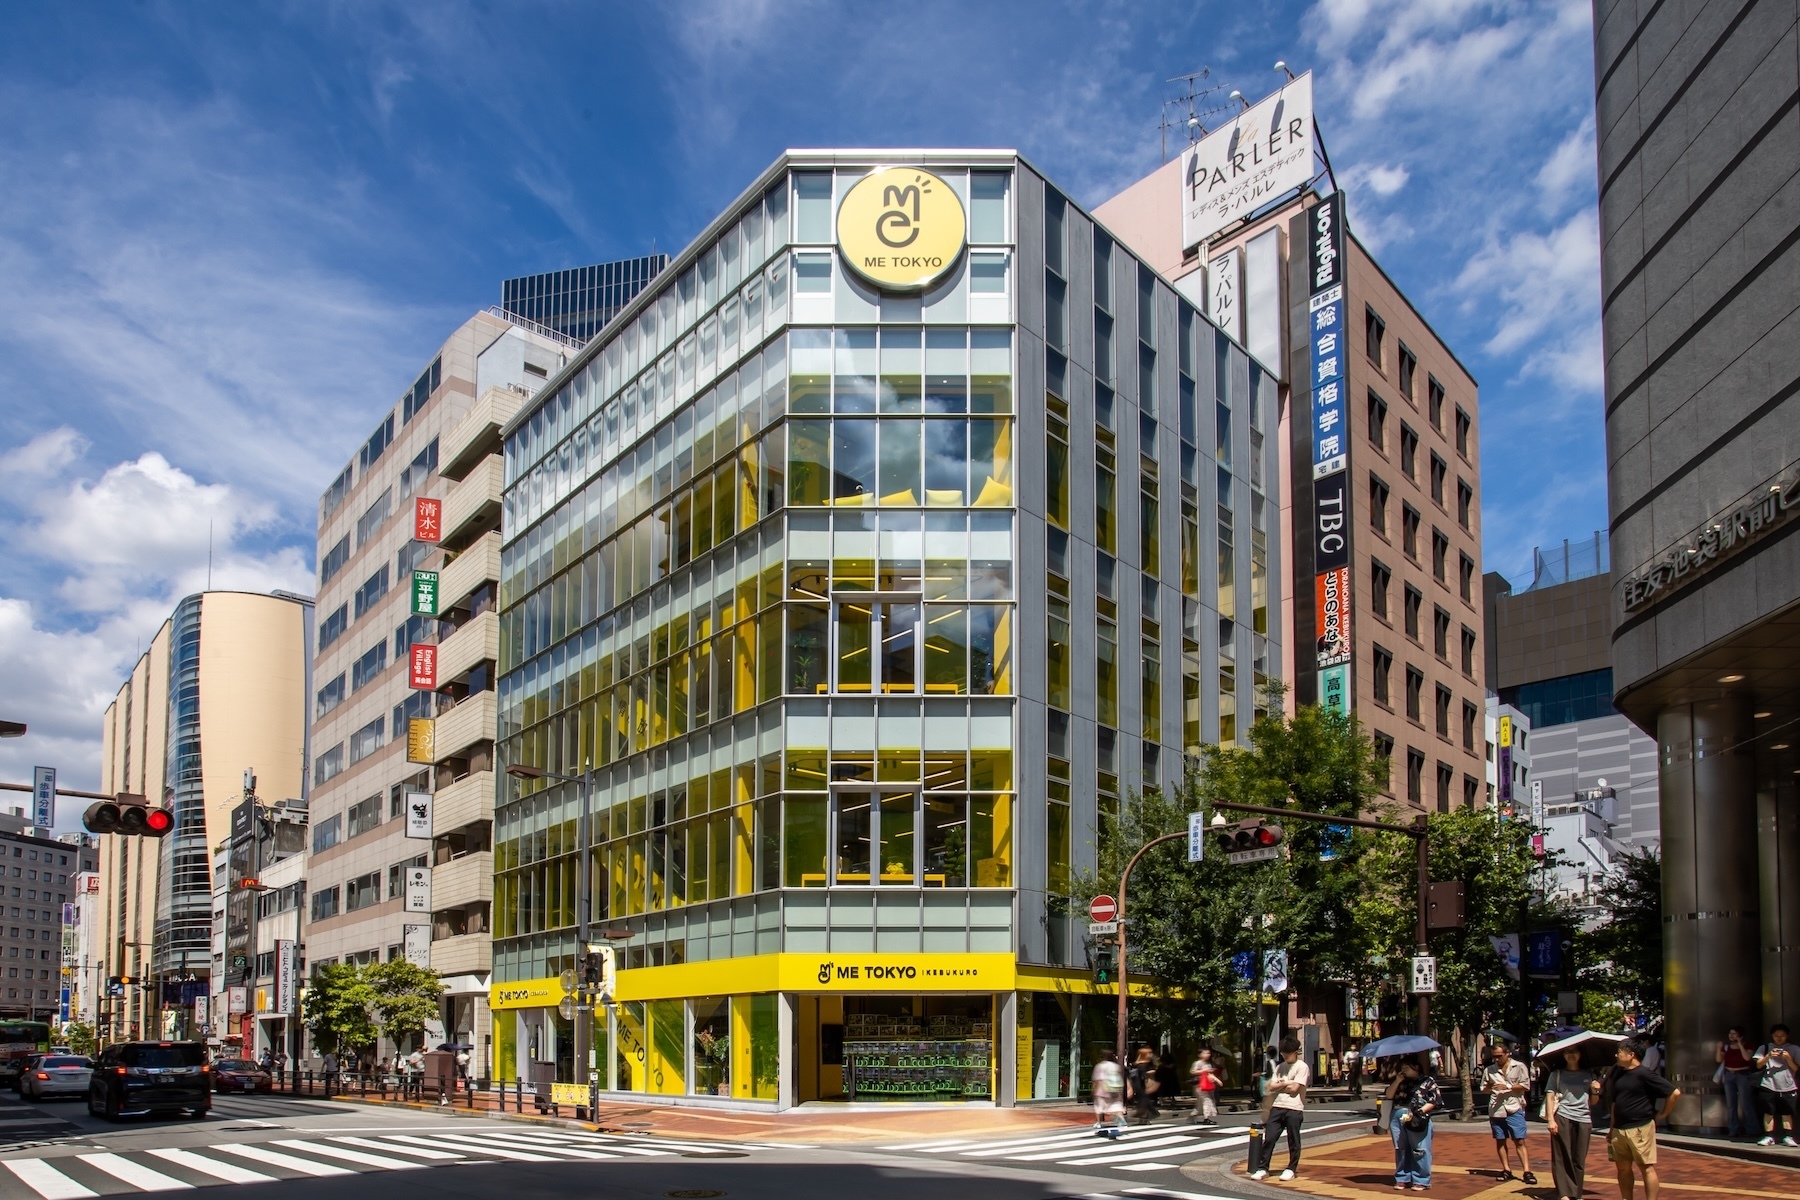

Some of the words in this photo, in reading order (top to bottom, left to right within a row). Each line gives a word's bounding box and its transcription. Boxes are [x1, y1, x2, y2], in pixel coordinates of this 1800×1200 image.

[1192, 118, 1304, 202] PARLER
[864, 256, 887, 268] ME
[891, 256, 943, 268] TOKYO
[1316, 306, 1340, 460] 総合資格学院
[419, 502, 438, 530] 清水
[1319, 488, 1345, 554] TBC
[418, 584, 433, 613] 平野屋
[1324, 571, 1341, 643] とらのあな
[424, 650, 433, 675] English
[1327, 677, 1341, 714] 高草
[1231, 847, 1276, 862] 自転車専用
[837, 966, 859, 979] ME
[865, 966, 917, 979] TOKYO
[616, 1019, 632, 1045] ME
